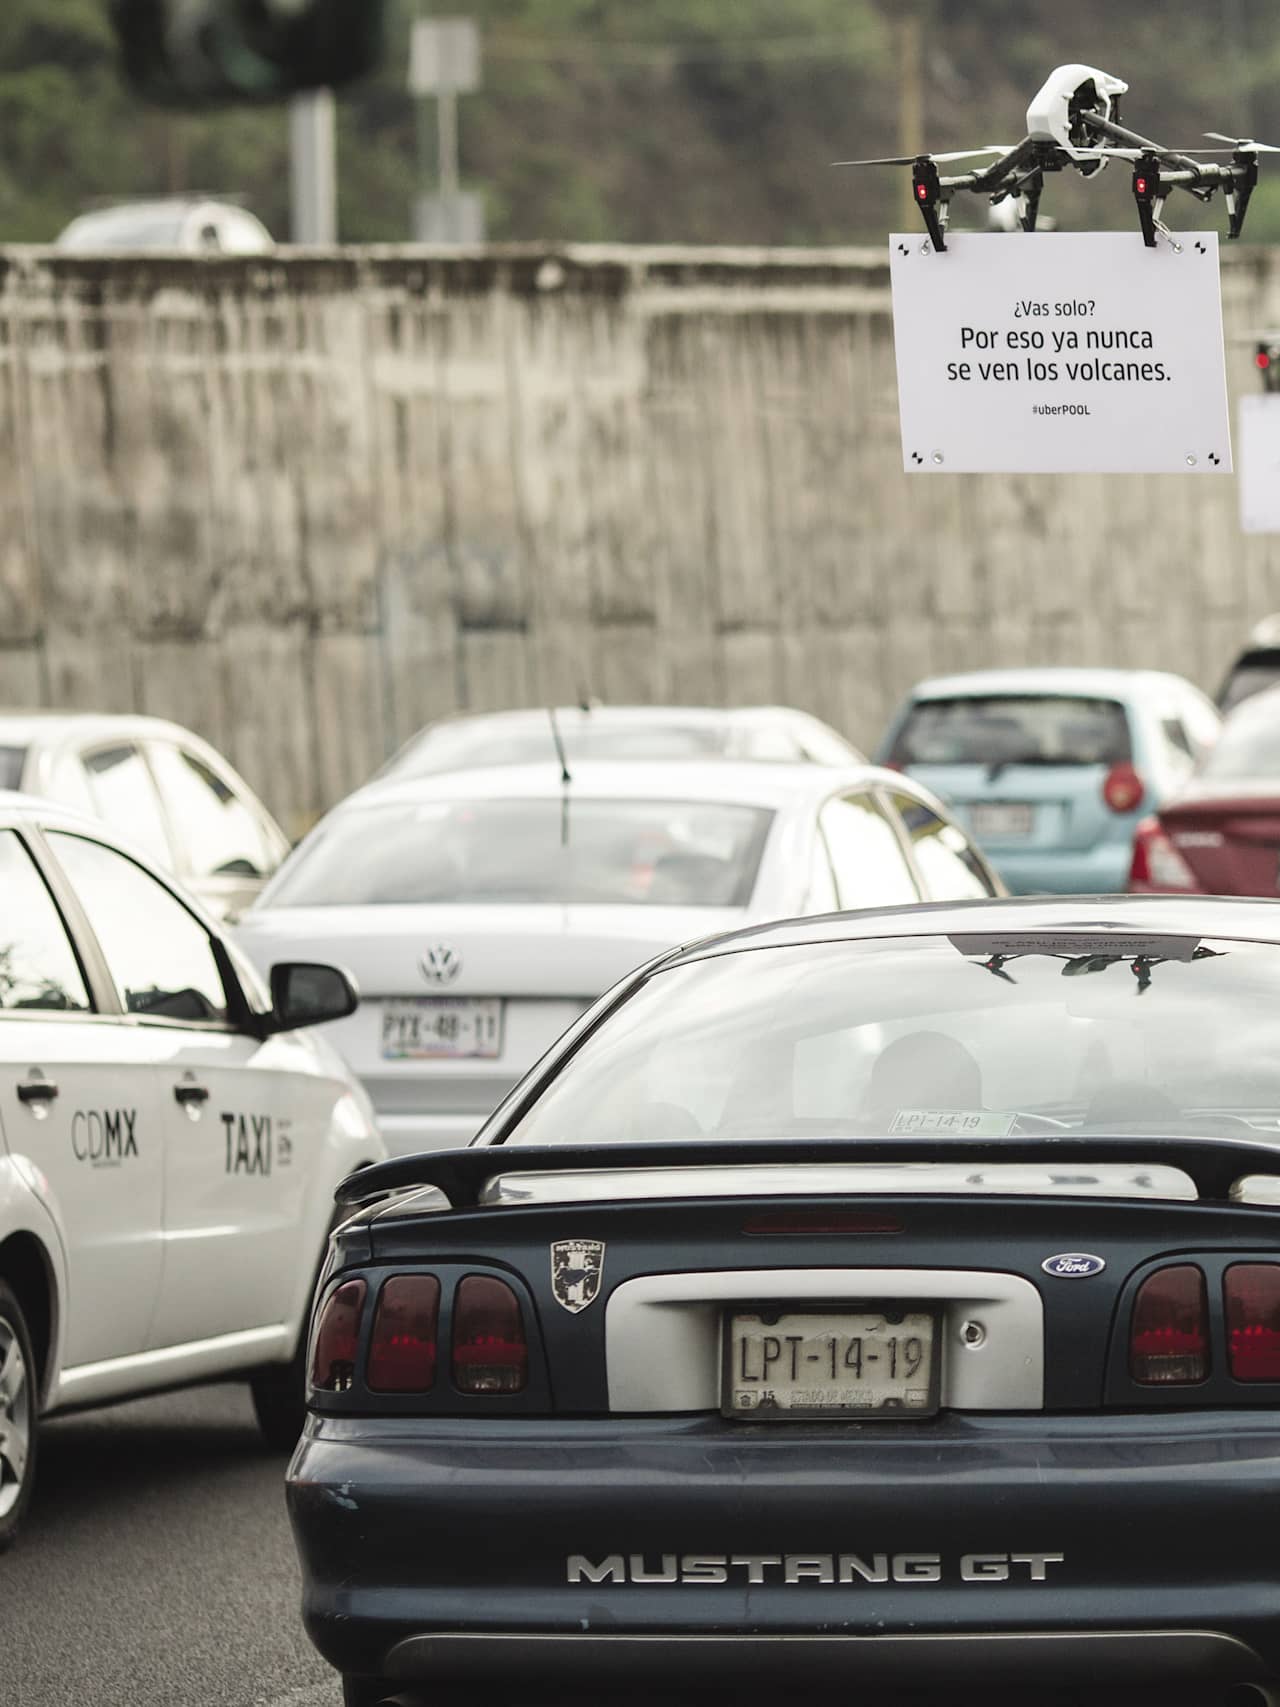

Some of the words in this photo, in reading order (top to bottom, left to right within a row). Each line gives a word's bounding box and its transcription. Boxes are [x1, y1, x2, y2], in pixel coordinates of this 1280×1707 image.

[1013, 300, 1050, 318] ¿Vas
[1054, 300, 1096, 317] solo?
[960, 326, 999, 349] Por
[1006, 330, 1045, 349] eso
[1052, 330, 1079, 352] ya
[1086, 330, 1154, 349] nunca
[947, 361, 971, 381] se
[978, 361, 1020, 381] ven
[1027, 358, 1059, 381] los
[1066, 358, 1172, 382] volcanes.
[1032, 404, 1091, 416] #uberPOOL
[71, 1108, 139, 1161] CDMX
[220, 1113, 272, 1177] TAXI
[1056, 1256, 1091, 1273] Ford
[740, 1336, 923, 1383] LPT-14-19
[567, 1552, 941, 1584] MUSTANG
[960, 1552, 1065, 1581] GT
